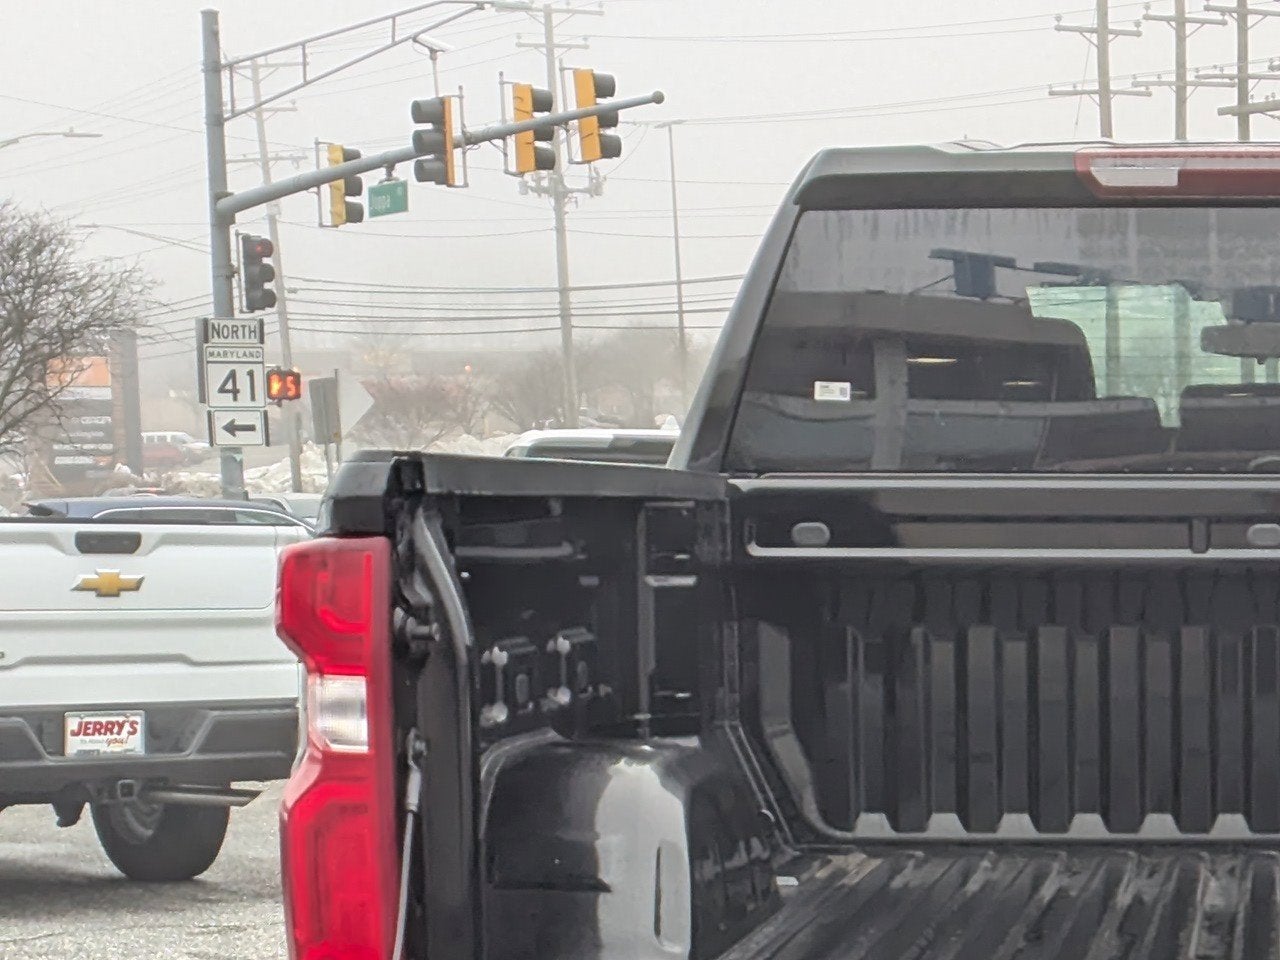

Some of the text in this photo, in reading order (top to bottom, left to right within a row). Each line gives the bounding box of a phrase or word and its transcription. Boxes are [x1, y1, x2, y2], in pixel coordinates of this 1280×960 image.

[211, 323, 257, 340] NORTH
[208, 350, 261, 359] MARYLAND
[217, 368, 256, 402] 41
[70, 720, 138, 737] JERRY'S
